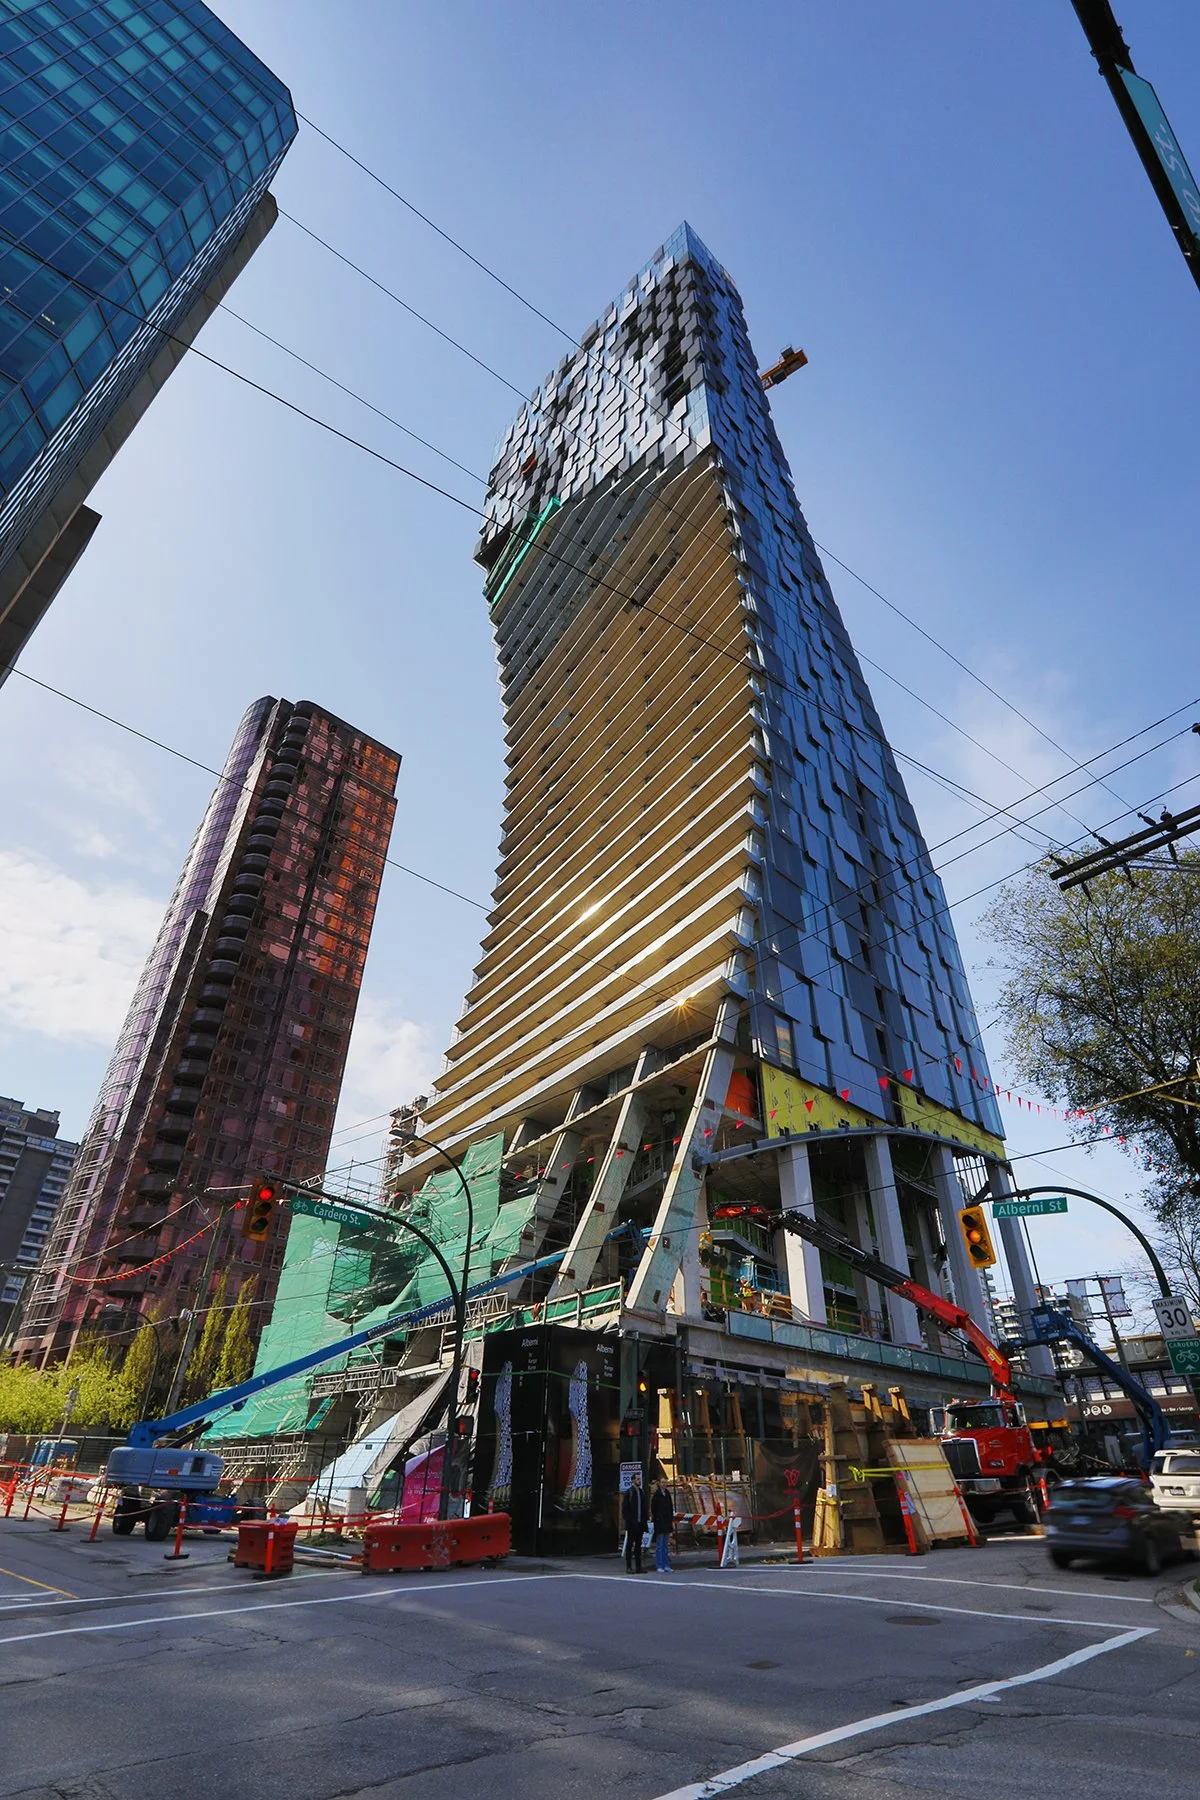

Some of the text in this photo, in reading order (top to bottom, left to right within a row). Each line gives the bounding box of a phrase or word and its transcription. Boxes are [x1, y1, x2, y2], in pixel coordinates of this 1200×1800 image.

[1155, 123, 1187, 180] St.
[314, 1204, 361, 1225] Cardero St.
[998, 1200, 1062, 1216] Alberni St
[1161, 1308, 1187, 1328] 30
